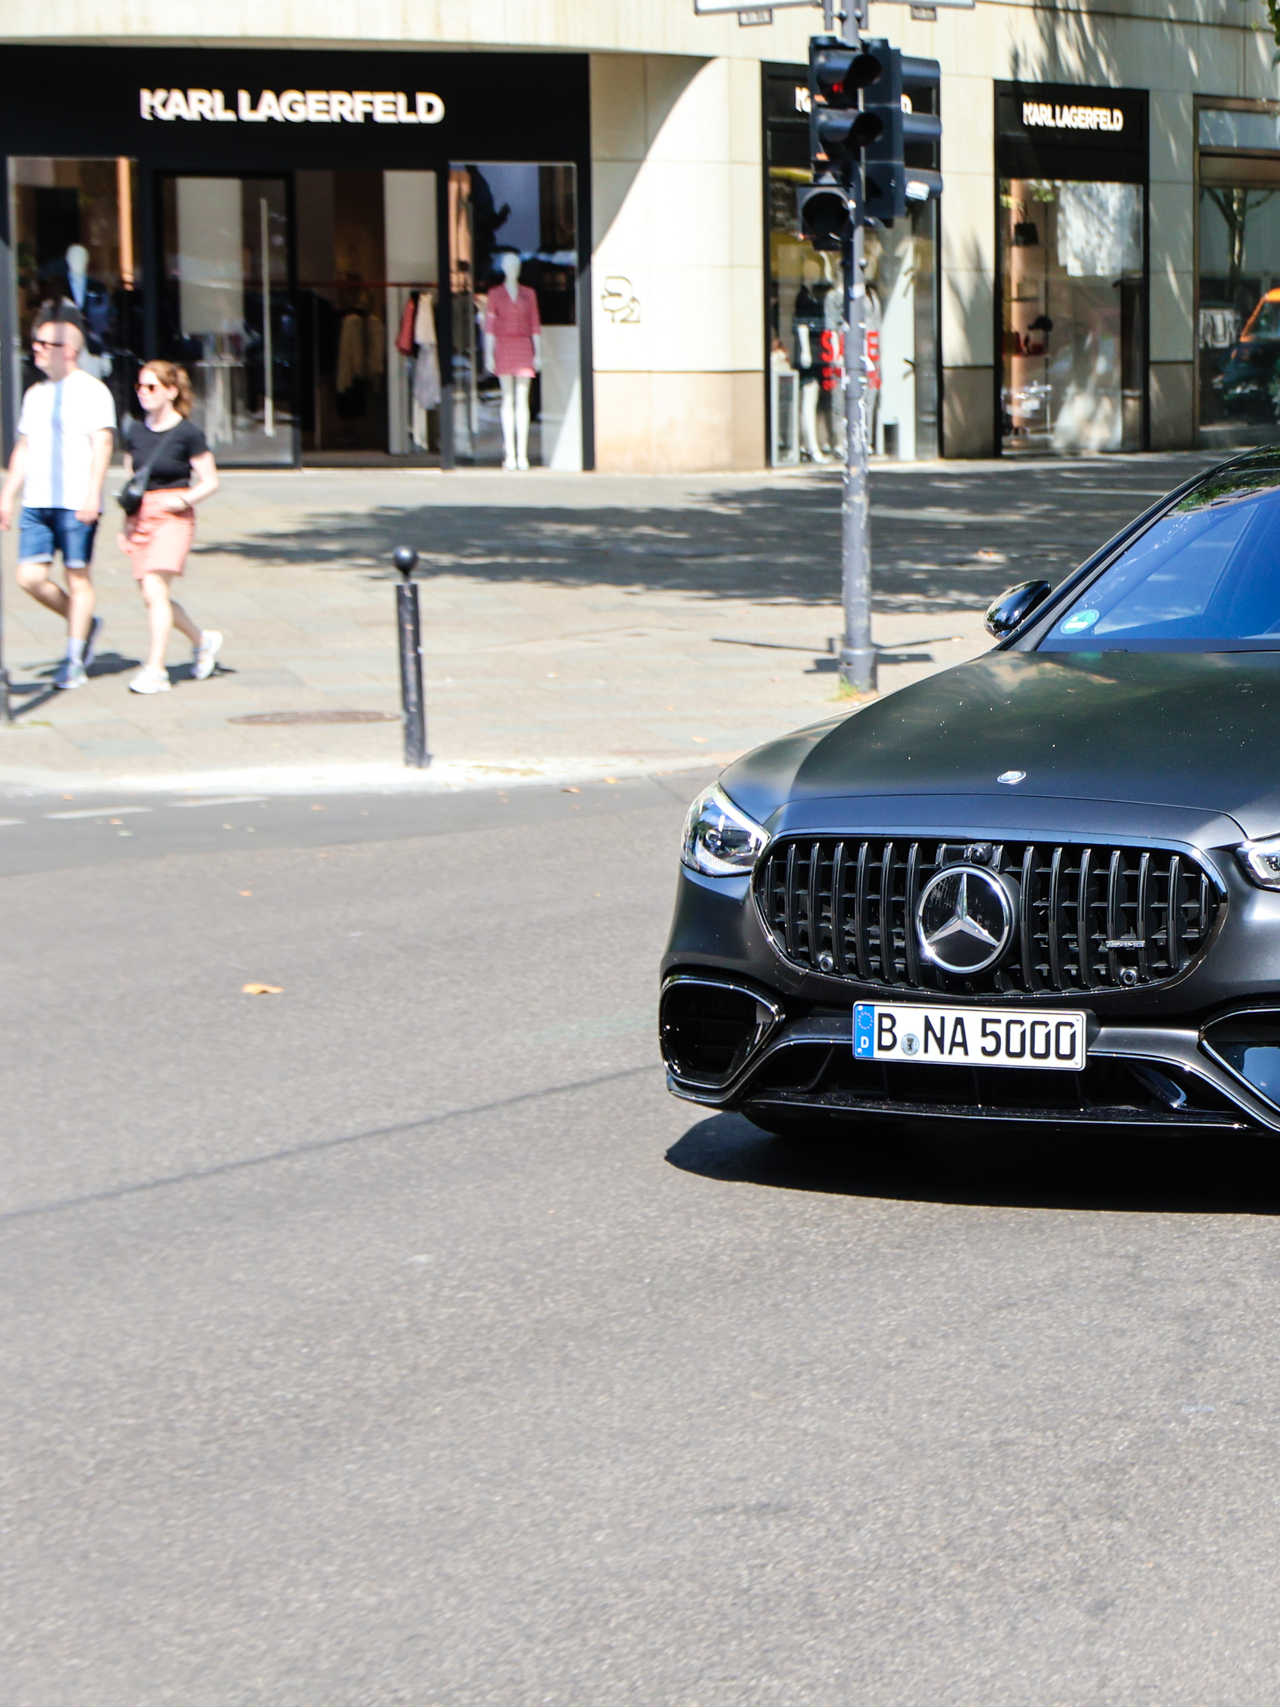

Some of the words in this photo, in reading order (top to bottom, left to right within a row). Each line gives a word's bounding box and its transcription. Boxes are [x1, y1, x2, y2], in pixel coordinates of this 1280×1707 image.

[140, 88, 237, 121] KARL
[237, 89, 445, 123] LAGERFELD
[1022, 102, 1056, 127] KARL
[1055, 104, 1124, 132] LAGERFELD
[821, 330, 880, 362] SE
[860, 1036, 870, 1049] D
[877, 1012, 897, 1052] B
[923, 1014, 969, 1056] NA
[980, 1018, 1077, 1060] 5000
